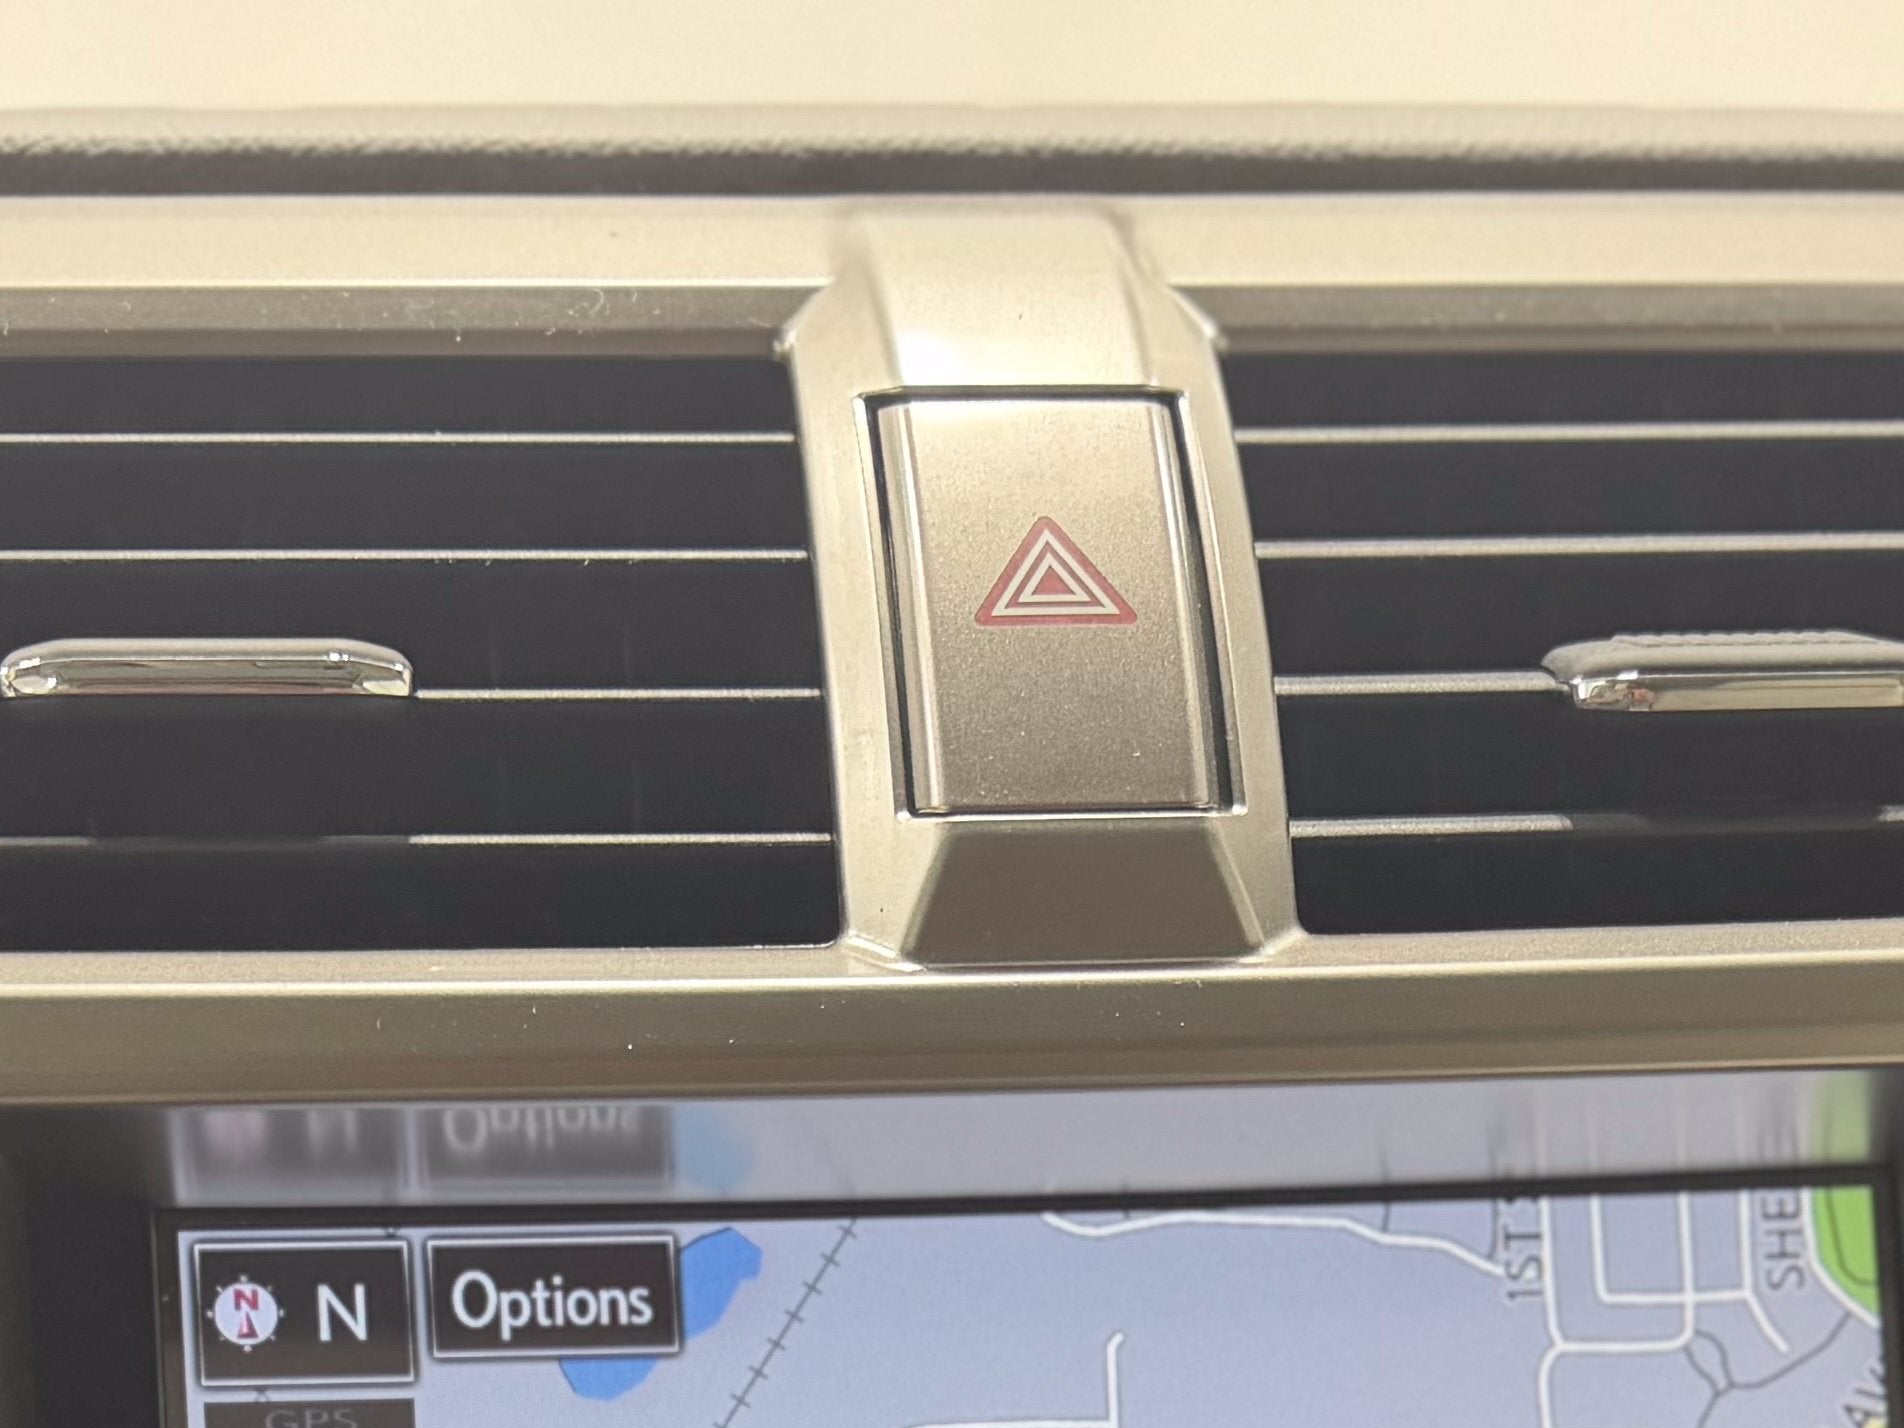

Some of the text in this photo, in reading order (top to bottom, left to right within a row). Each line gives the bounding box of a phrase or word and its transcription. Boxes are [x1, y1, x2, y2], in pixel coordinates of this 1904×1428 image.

[233, 1289, 259, 1311] N
[316, 1284, 368, 1342] N
[452, 1269, 653, 1341] Options
